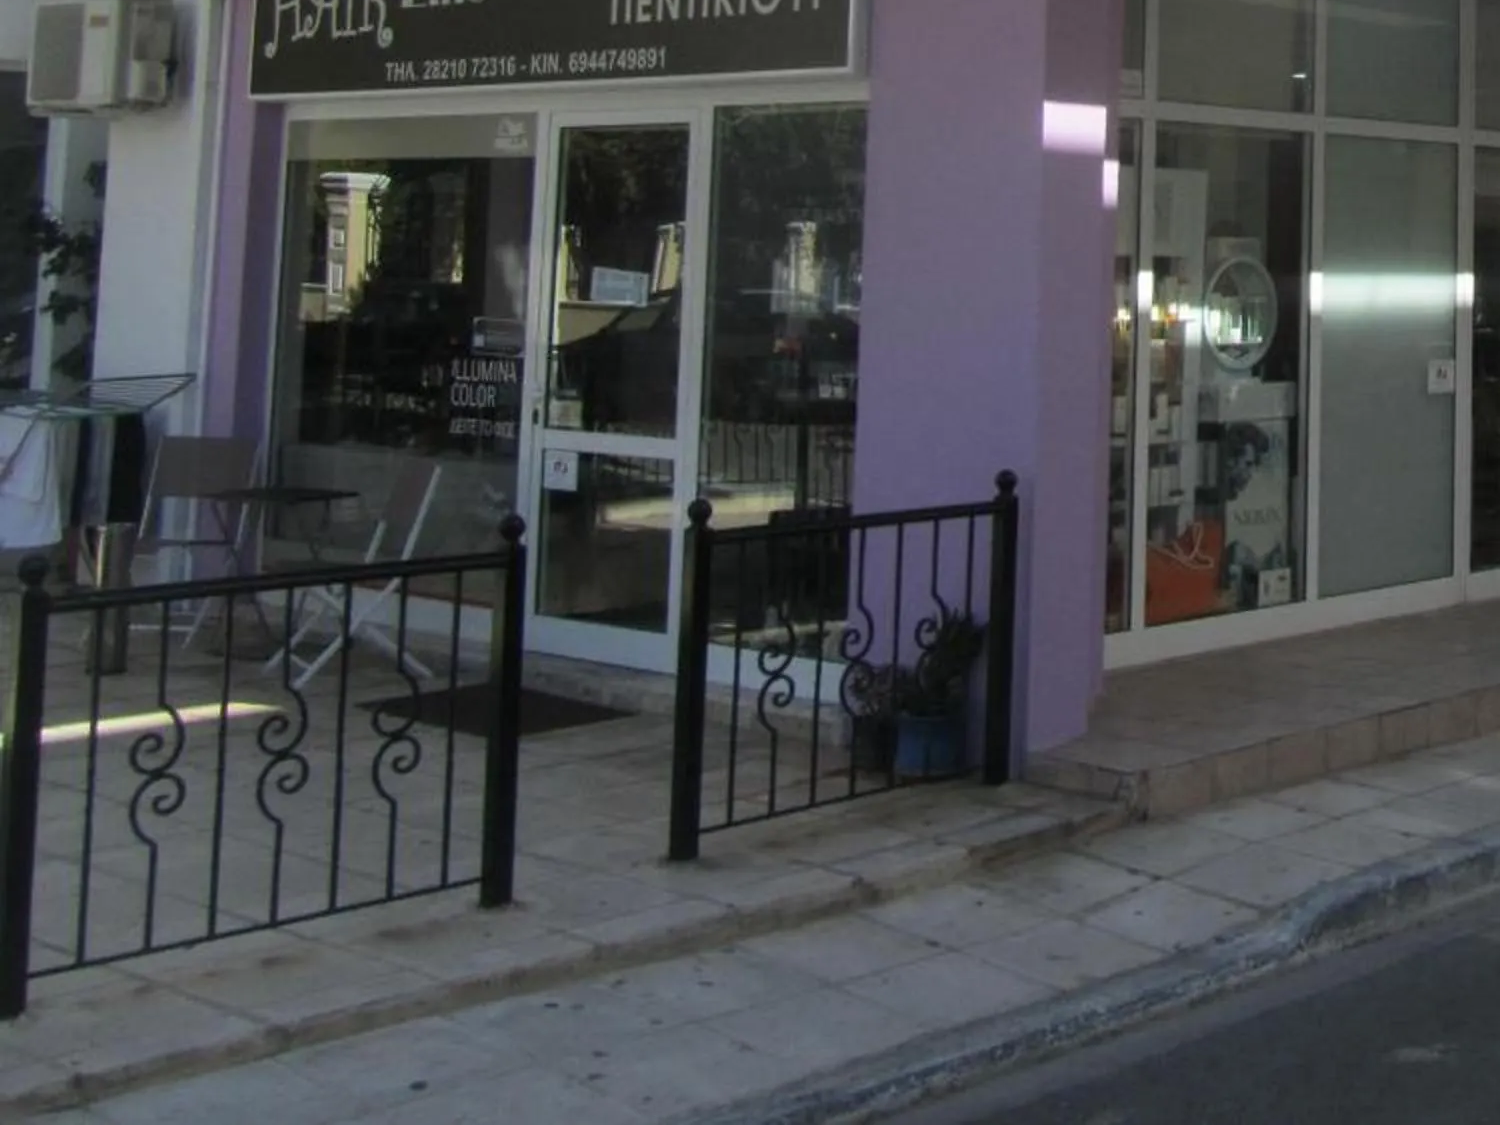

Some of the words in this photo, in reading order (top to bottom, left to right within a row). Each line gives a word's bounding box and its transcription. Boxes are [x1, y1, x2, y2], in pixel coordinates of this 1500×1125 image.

[422, 58, 467, 81] 28210
[471, 55, 517, 77] 72316
[568, 46, 667, 73] 6944749891
[450, 382, 497, 409] COLOR
